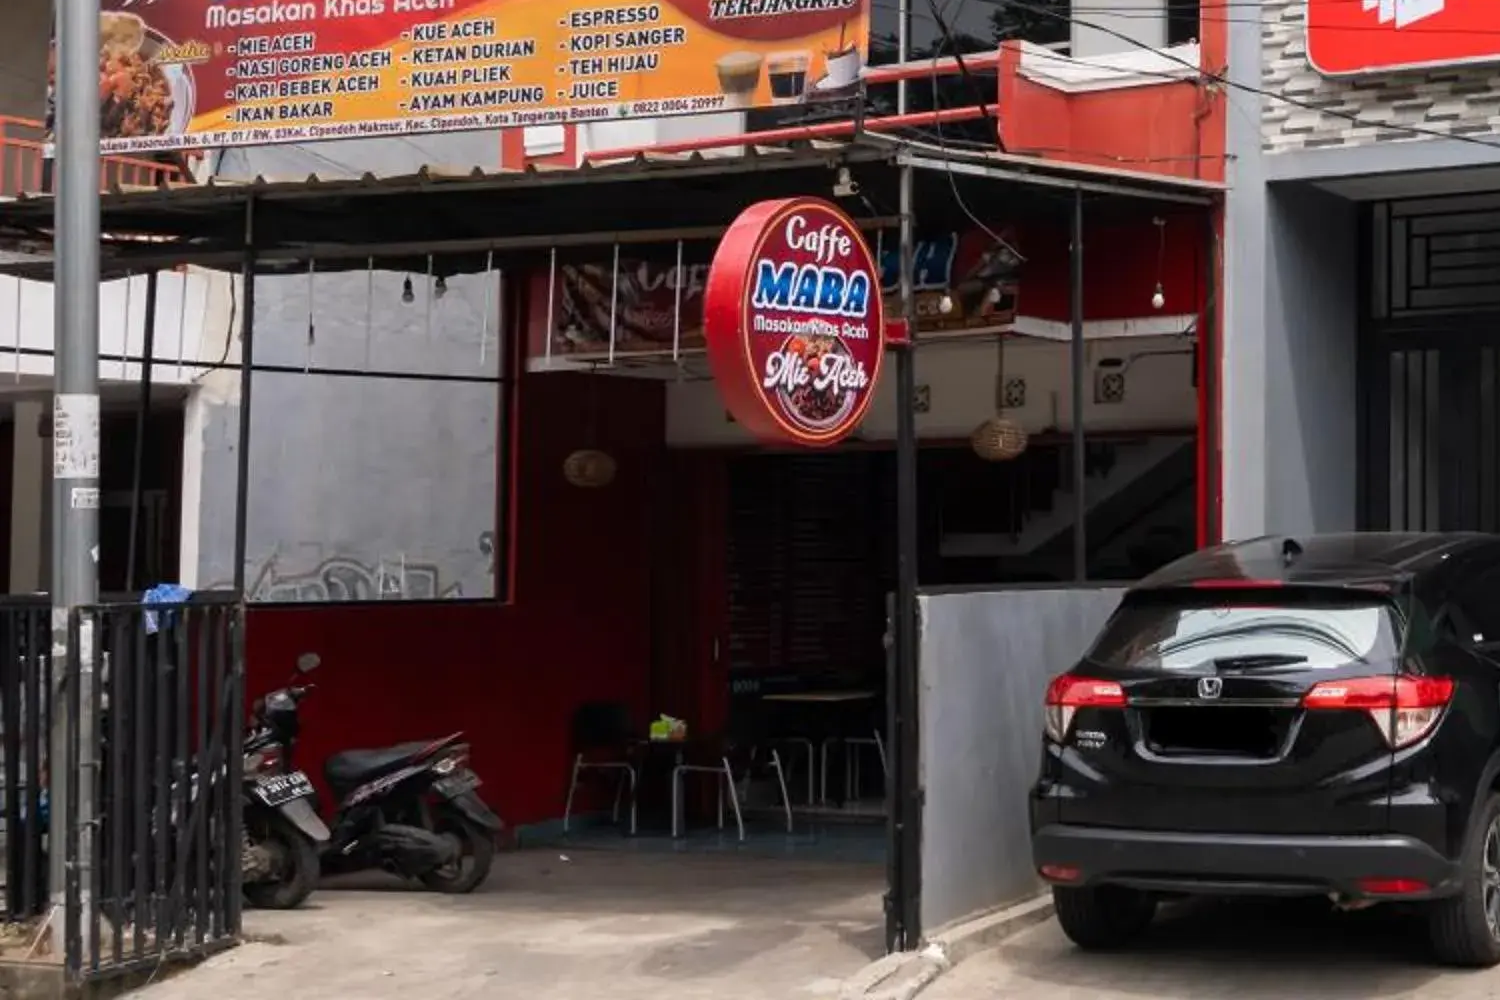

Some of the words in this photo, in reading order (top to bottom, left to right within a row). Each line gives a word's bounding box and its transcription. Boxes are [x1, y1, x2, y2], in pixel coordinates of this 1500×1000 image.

[206, 1, 316, 28] Masakan
[571, 6, 659, 28] ESPRESSO
[413, 24, 446, 41] KUE
[451, 20, 495, 37] ACEH
[571, 33, 612, 52] KOPI
[616, 28, 685, 48] SANGER
[239, 37, 267, 55] MIE
[273, 35, 314, 51] ACEH
[413, 46, 467, 64] KETAN
[471, 40, 535, 59] DURIAN
[238, 61, 275, 77] NASI
[280, 56, 344, 73] GORENG
[348, 52, 391, 68] ACEH
[570, 59, 603, 76] TEH
[608, 53, 658, 72] HIJAU
[236, 84, 274, 100] KARI
[280, 80, 331, 97] BEBEK
[336, 76, 379, 92] ACEH
[411, 71, 457, 87] KUAH
[462, 66, 511, 83] PLIEK
[410, 94, 455, 111] AYAM
[461, 88, 543, 107] KAMPUNG
[569, 81, 617, 99] JUICE
[236, 106, 274, 121] IKAN
[280, 102, 333, 119] BAKAR
[786, 215, 851, 264] Caffe
[752, 260, 870, 317] MABA
[754, 315, 808, 335] Masakan
[764, 352, 810, 392] Mie
[814, 354, 868, 395] Aceh
